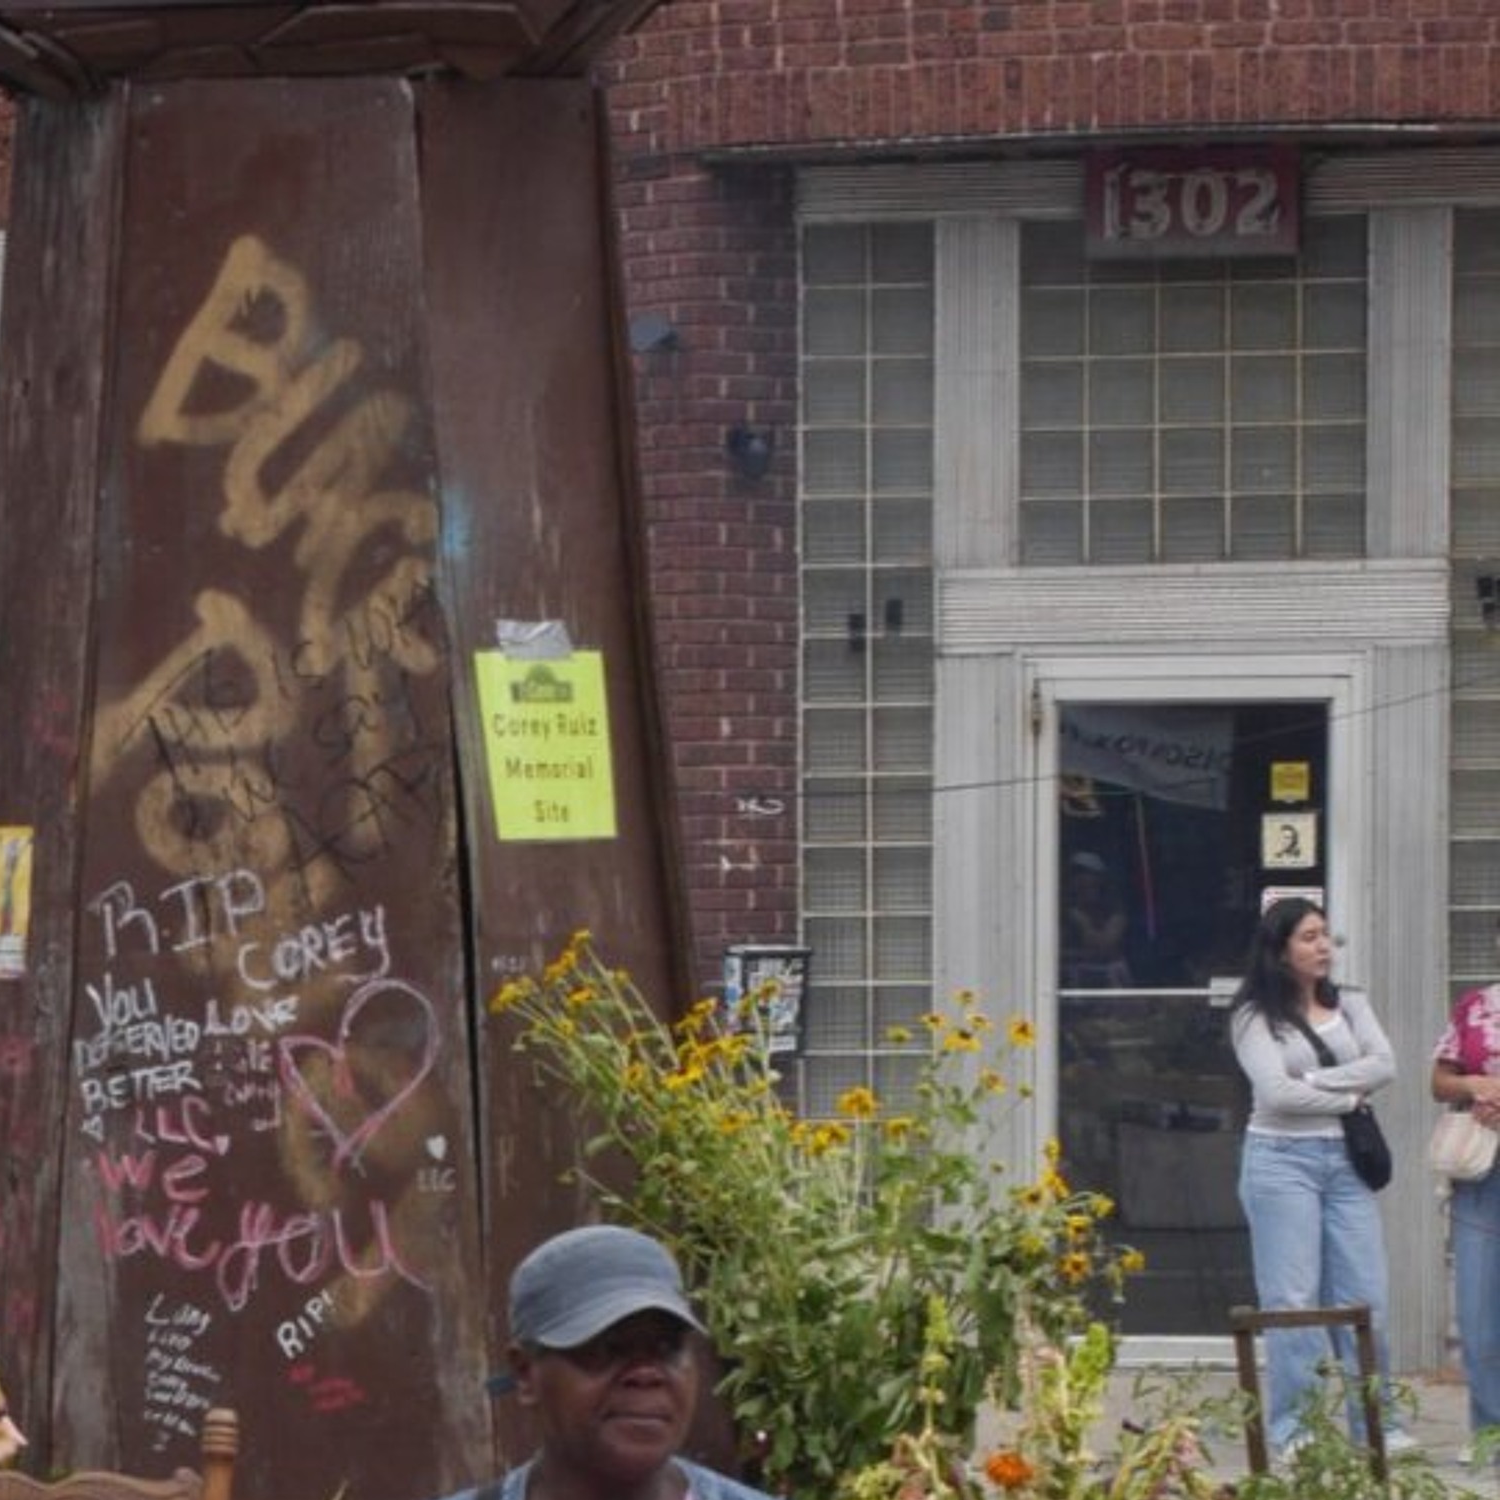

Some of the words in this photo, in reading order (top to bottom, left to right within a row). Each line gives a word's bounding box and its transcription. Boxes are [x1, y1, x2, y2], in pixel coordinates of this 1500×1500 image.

[1103, 164, 1281, 240] 1302
[493, 713, 550, 741] Corey
[557, 713, 599, 737] Ruiz
[505, 757, 595, 780] Memorial
[533, 799, 571, 823] Site
